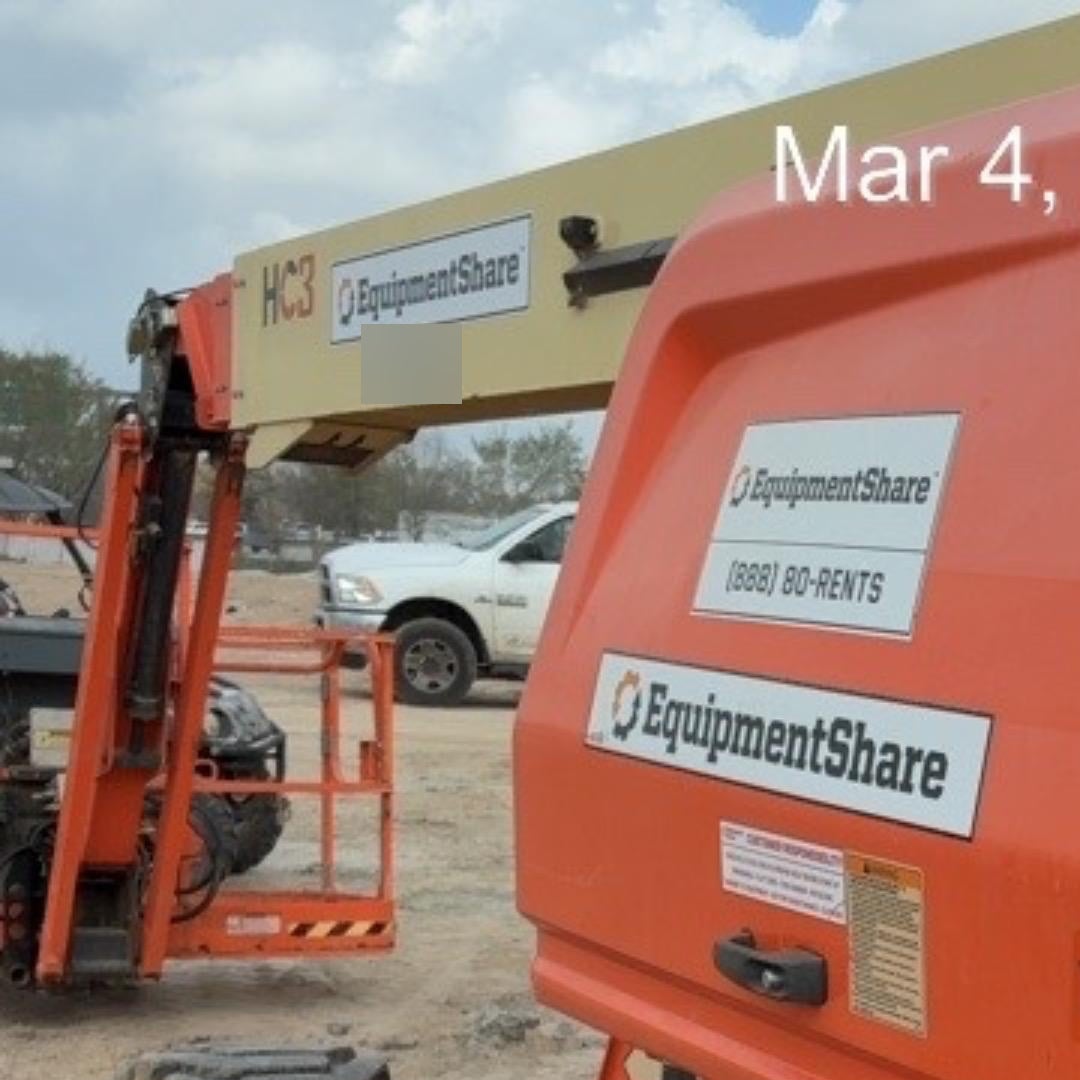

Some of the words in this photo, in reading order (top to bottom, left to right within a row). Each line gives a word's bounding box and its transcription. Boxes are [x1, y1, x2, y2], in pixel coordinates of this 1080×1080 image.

[356, 251, 520, 321] EquipmentShare
[749, 467, 932, 509] EquipmentShare
[726, 559, 779, 597] (888)
[781, 564, 886, 604] 80-RENTS
[642, 682, 949, 801] EquipmentShare
